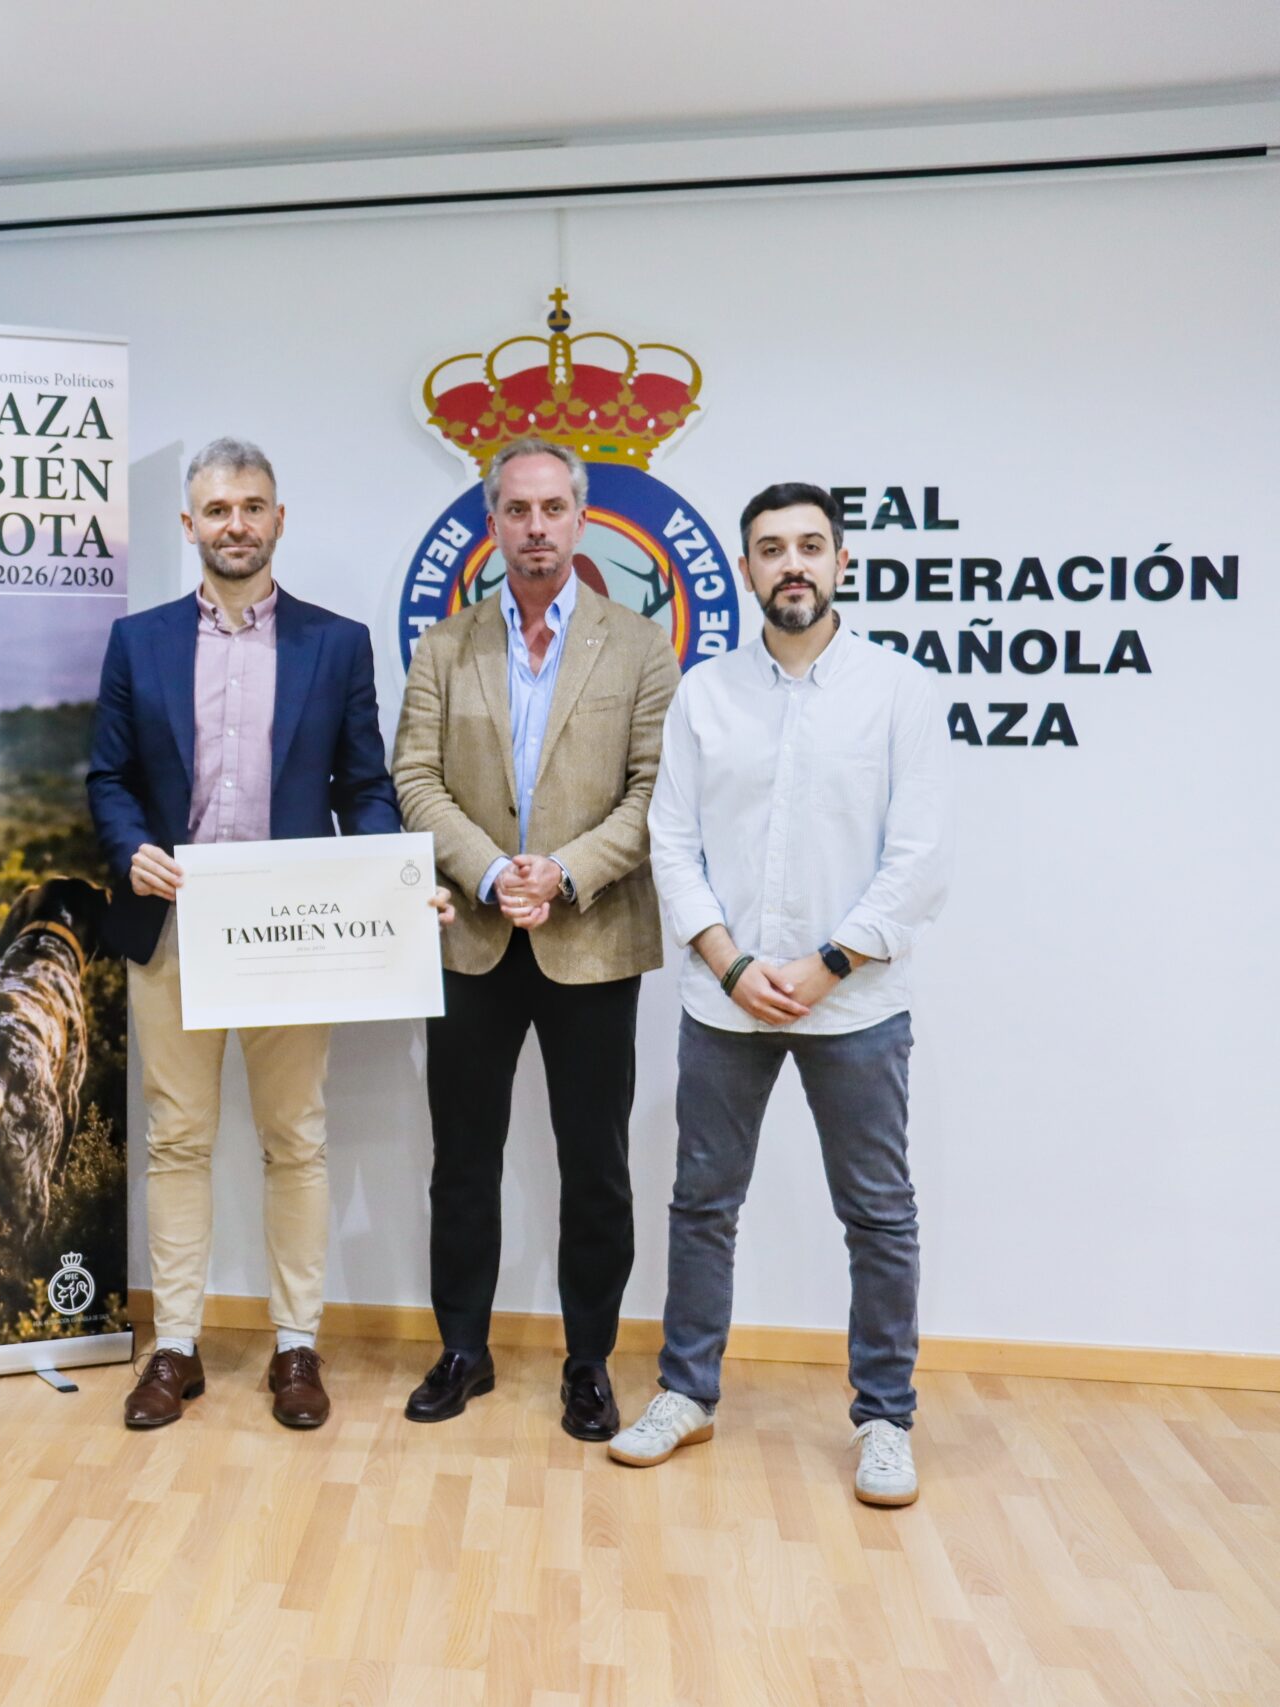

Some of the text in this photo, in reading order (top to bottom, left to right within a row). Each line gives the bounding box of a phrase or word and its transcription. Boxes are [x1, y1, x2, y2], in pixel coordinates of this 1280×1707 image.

[54, 372, 114, 389] Políticos
[830, 486, 959, 530] EAL
[410, 517, 473, 603] REAL
[662, 507, 729, 655] DE CAZA
[834, 543, 1239, 602] EDERACIÓN
[850, 618, 1152, 675] PAÑOLA
[947, 703, 1079, 746] AZA
[221, 919, 396, 945] TAMBIÉN VOTA
[270, 903, 341, 917] LA CAZA
